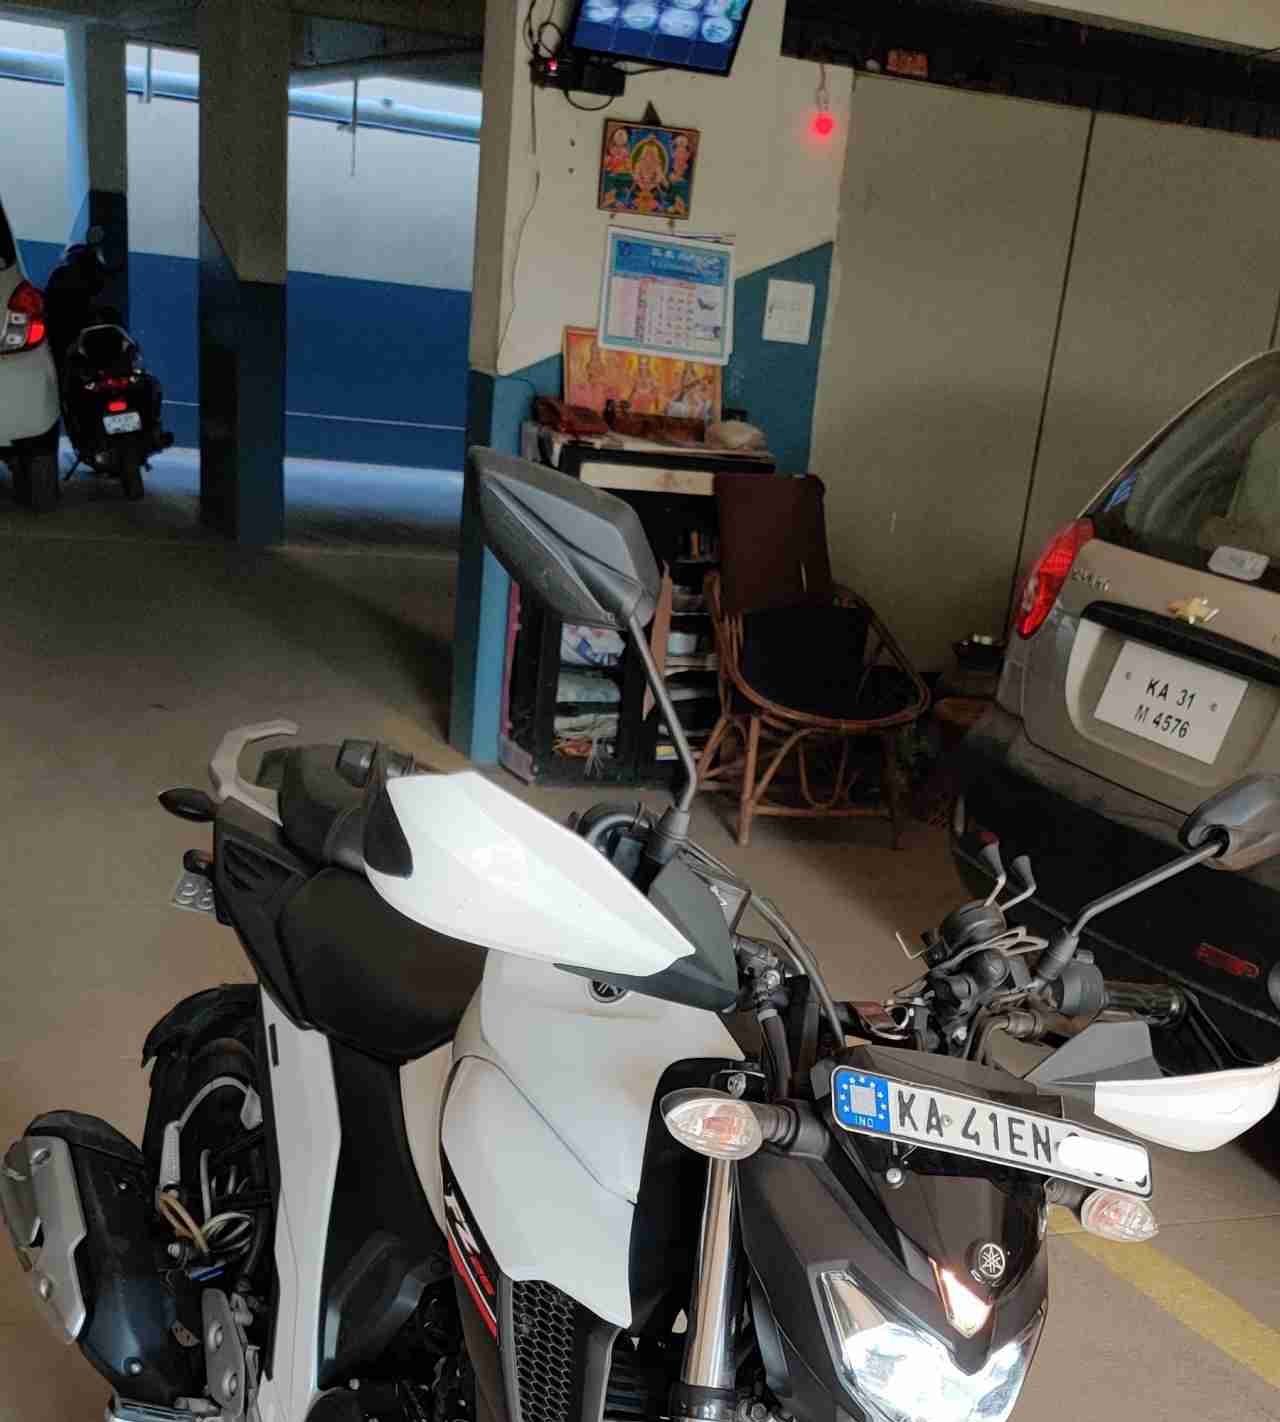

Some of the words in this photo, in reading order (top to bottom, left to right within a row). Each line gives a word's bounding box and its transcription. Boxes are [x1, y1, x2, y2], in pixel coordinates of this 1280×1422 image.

[1145, 677, 1169, 701] KA
[1176, 689, 1195, 711] 31
[1134, 704, 1150, 723] M
[1152, 712, 1190, 738] 4576
[897, 1088, 944, 1138] KA
[961, 1106, 1052, 1164] 41EN
